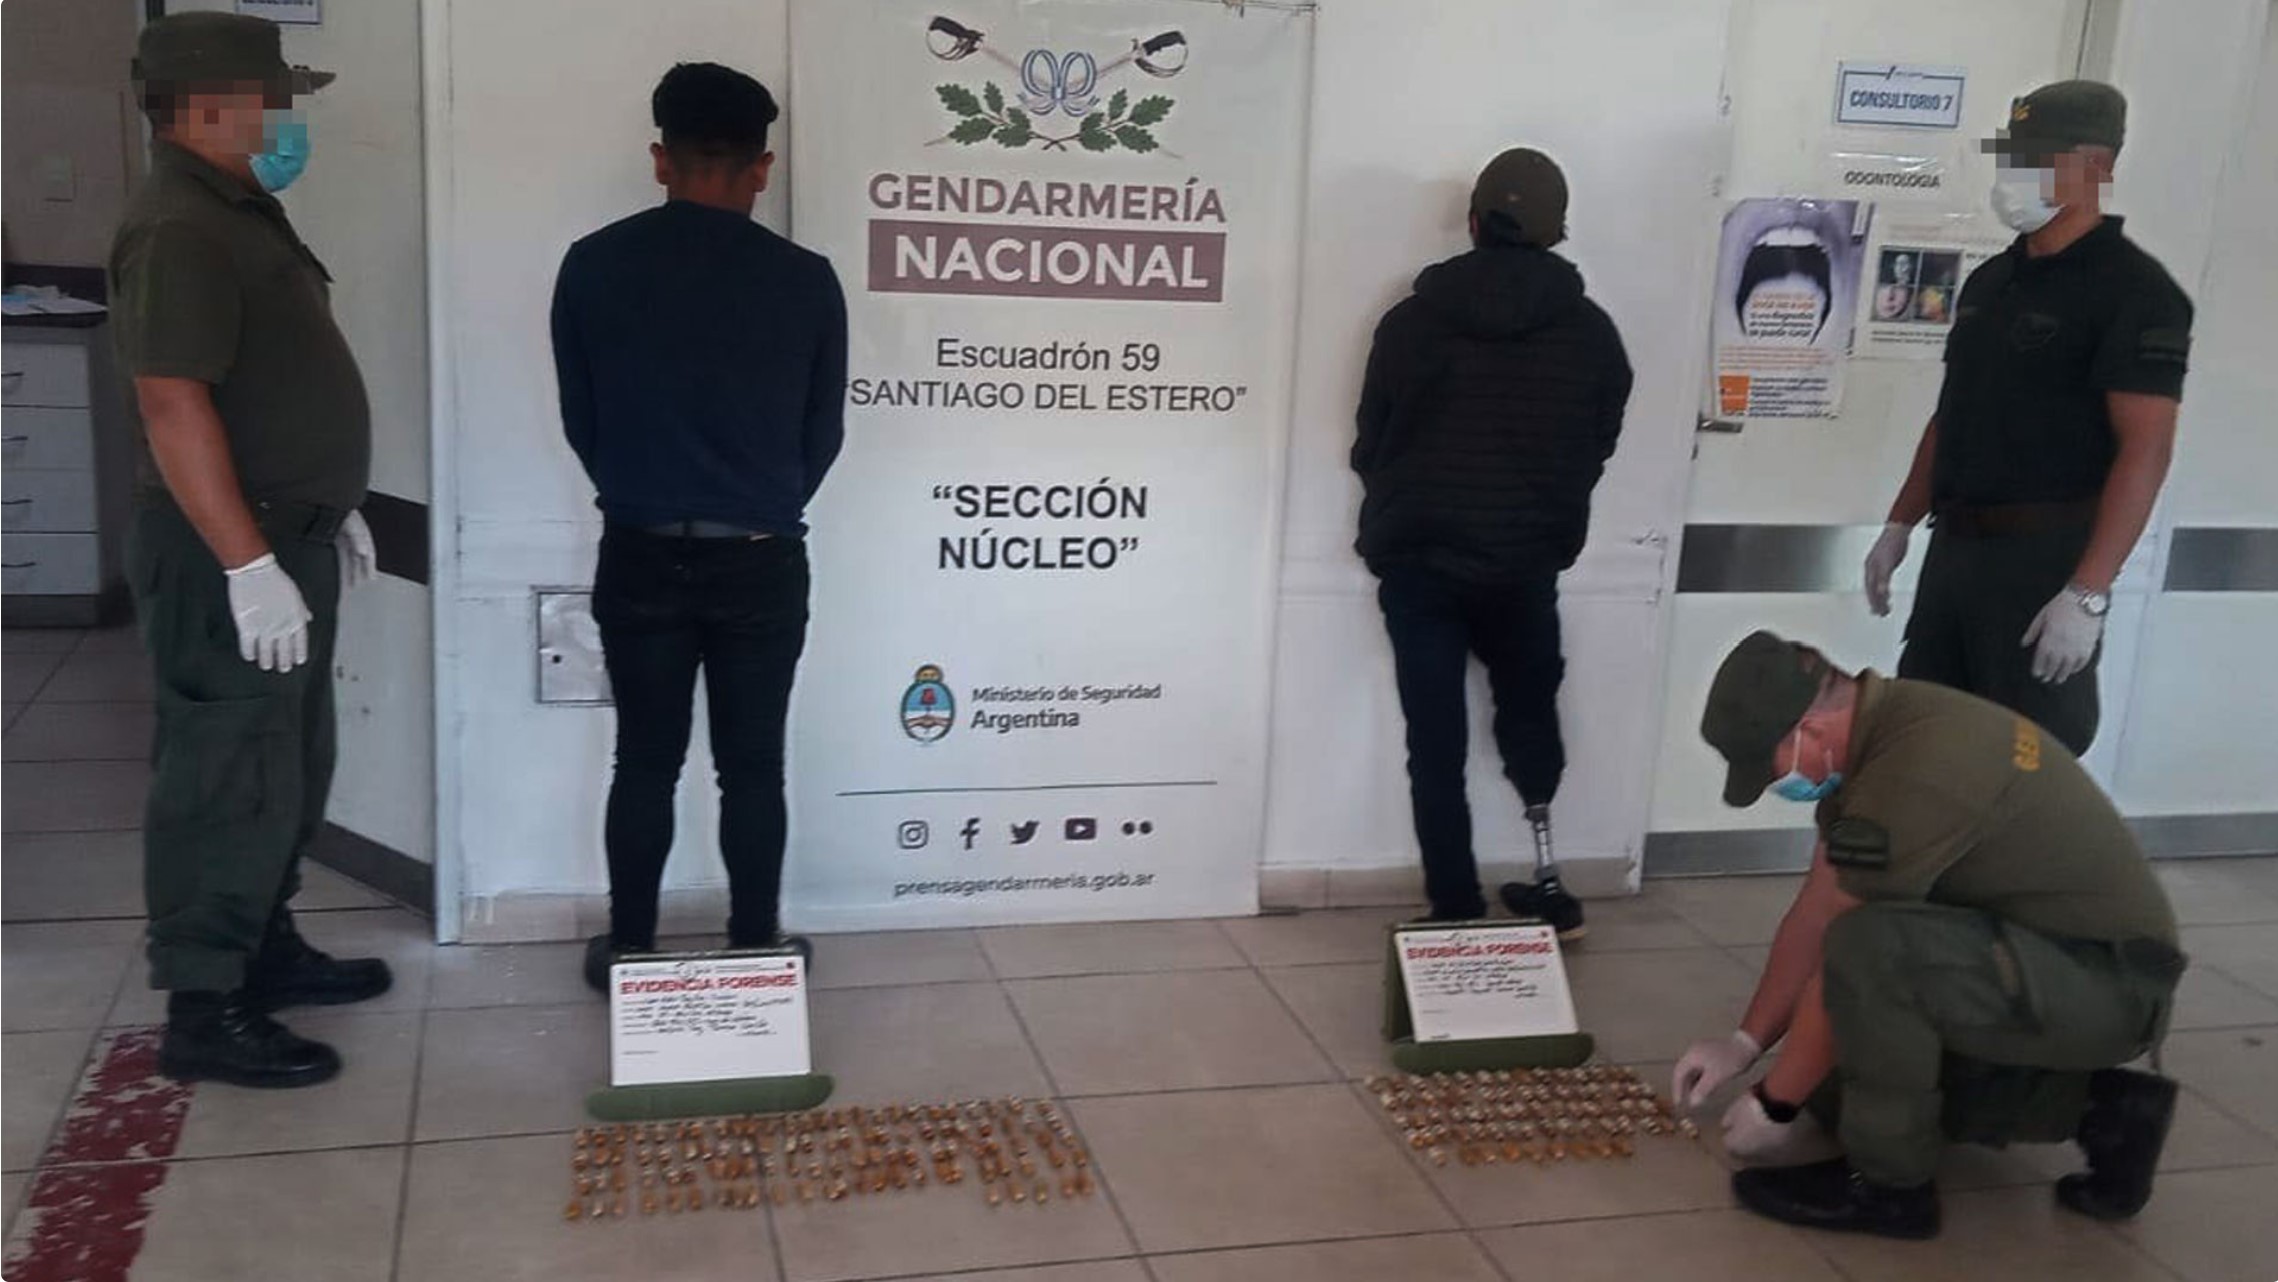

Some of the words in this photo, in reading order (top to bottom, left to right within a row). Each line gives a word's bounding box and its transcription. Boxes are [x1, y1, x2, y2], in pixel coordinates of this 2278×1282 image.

[1850, 90, 1940, 110] CONSULTORIO
[1942, 94, 1954, 111] 7
[869, 173, 1226, 223] GENDARMERÍA
[896, 235, 1208, 289] NACIONAL
[936, 338, 1110, 371] Escuadrón
[1121, 343, 1160, 372] 59
[849, 378, 1025, 410] SANTIAGO
[1034, 384, 1097, 410] DEL
[933, 476, 1148, 518] “SECCIÓN
[938, 527, 1140, 570] NÚCLEO”
[971, 685, 1055, 702] Ministerio
[1058, 685, 1079, 701] de
[1081, 683, 1162, 704] Seguridad
[970, 708, 1080, 733] Argentina
[1407, 946, 1484, 960] EVIDENCIA
[620, 977, 713, 994] EVIDENCIA
[718, 974, 798, 989] FORENSE
